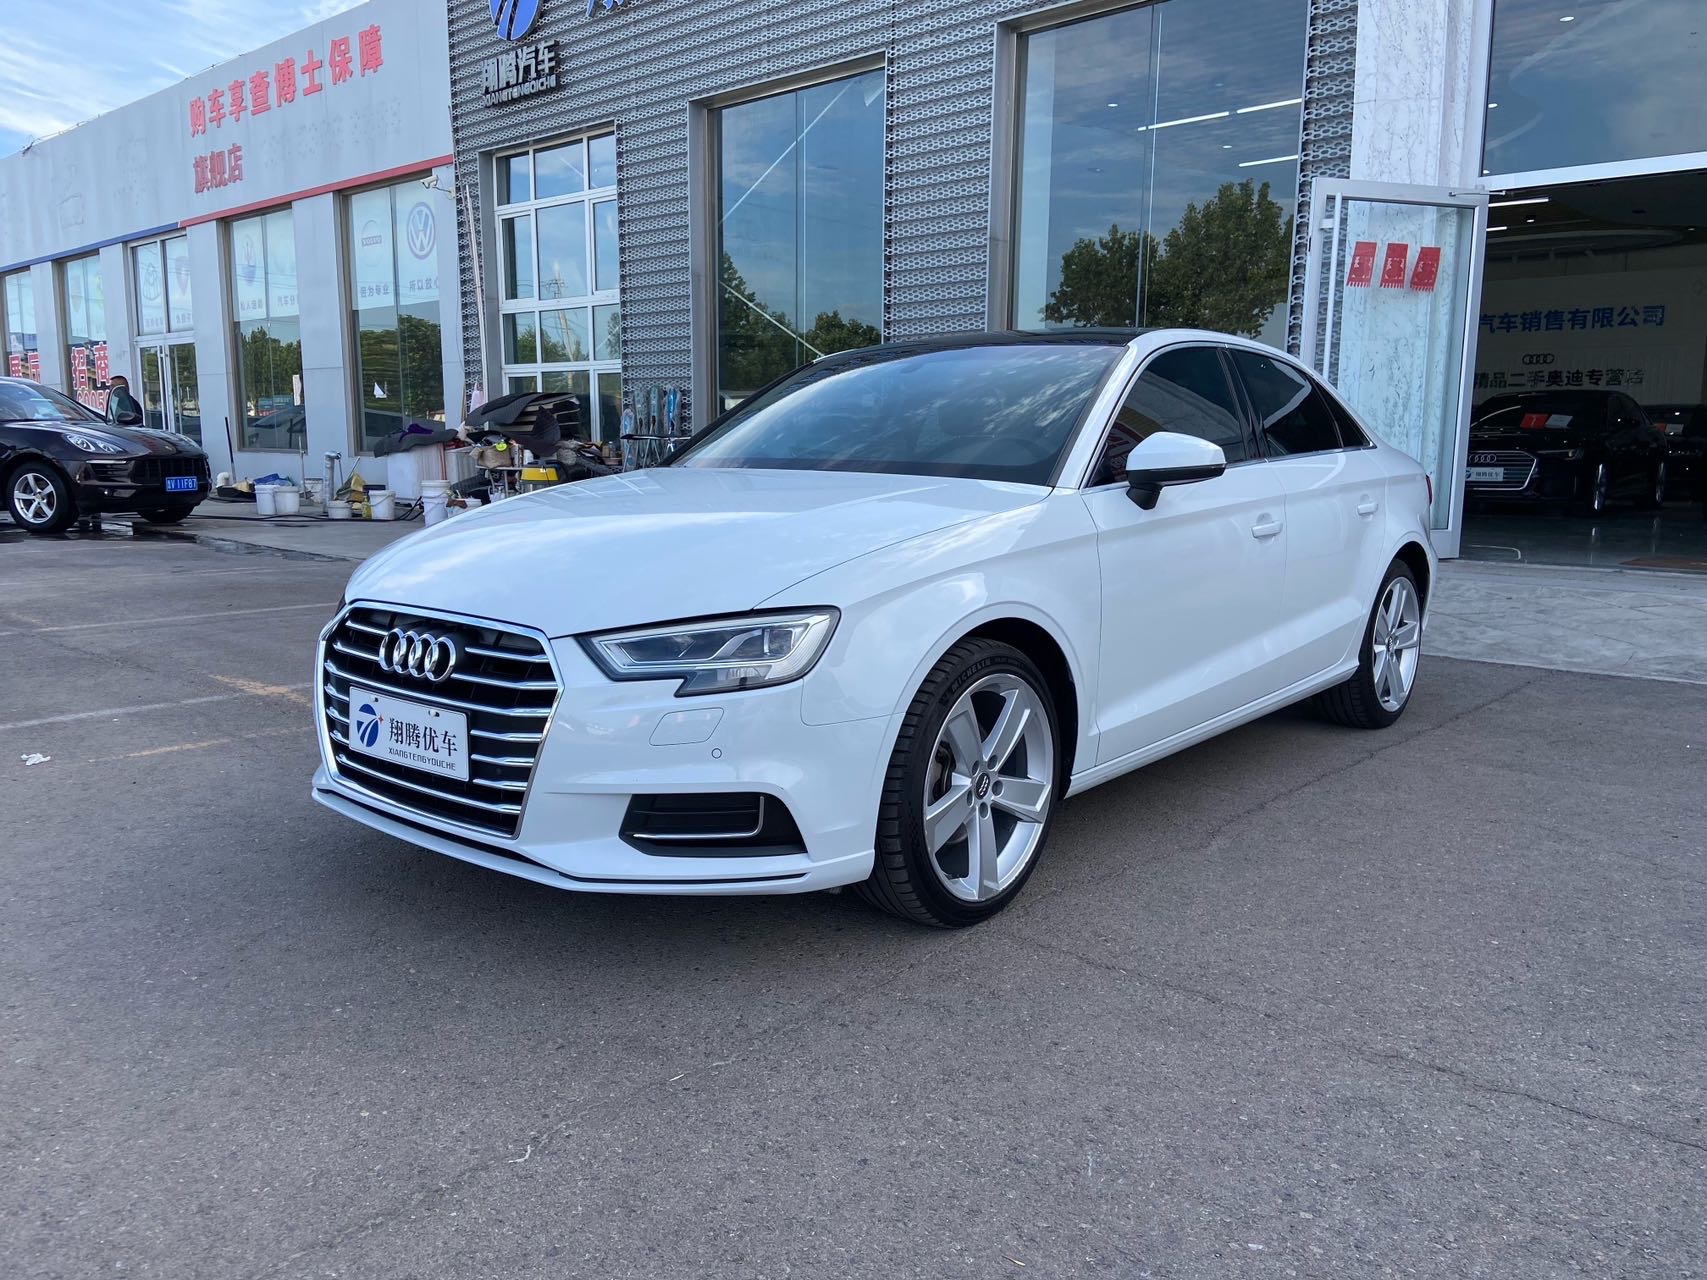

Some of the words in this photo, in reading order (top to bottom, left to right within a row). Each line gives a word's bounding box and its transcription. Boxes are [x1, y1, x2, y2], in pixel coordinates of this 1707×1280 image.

[190, 24, 383, 137] 购车享查博士保障
[193, 143, 243, 193] 旗舰店
[1479, 305, 1665, 333] 汽车销售有限公司
[389, 718, 458, 757] 翔腾优车
[388, 747, 456, 771] XIANGTENGYOUCHE
